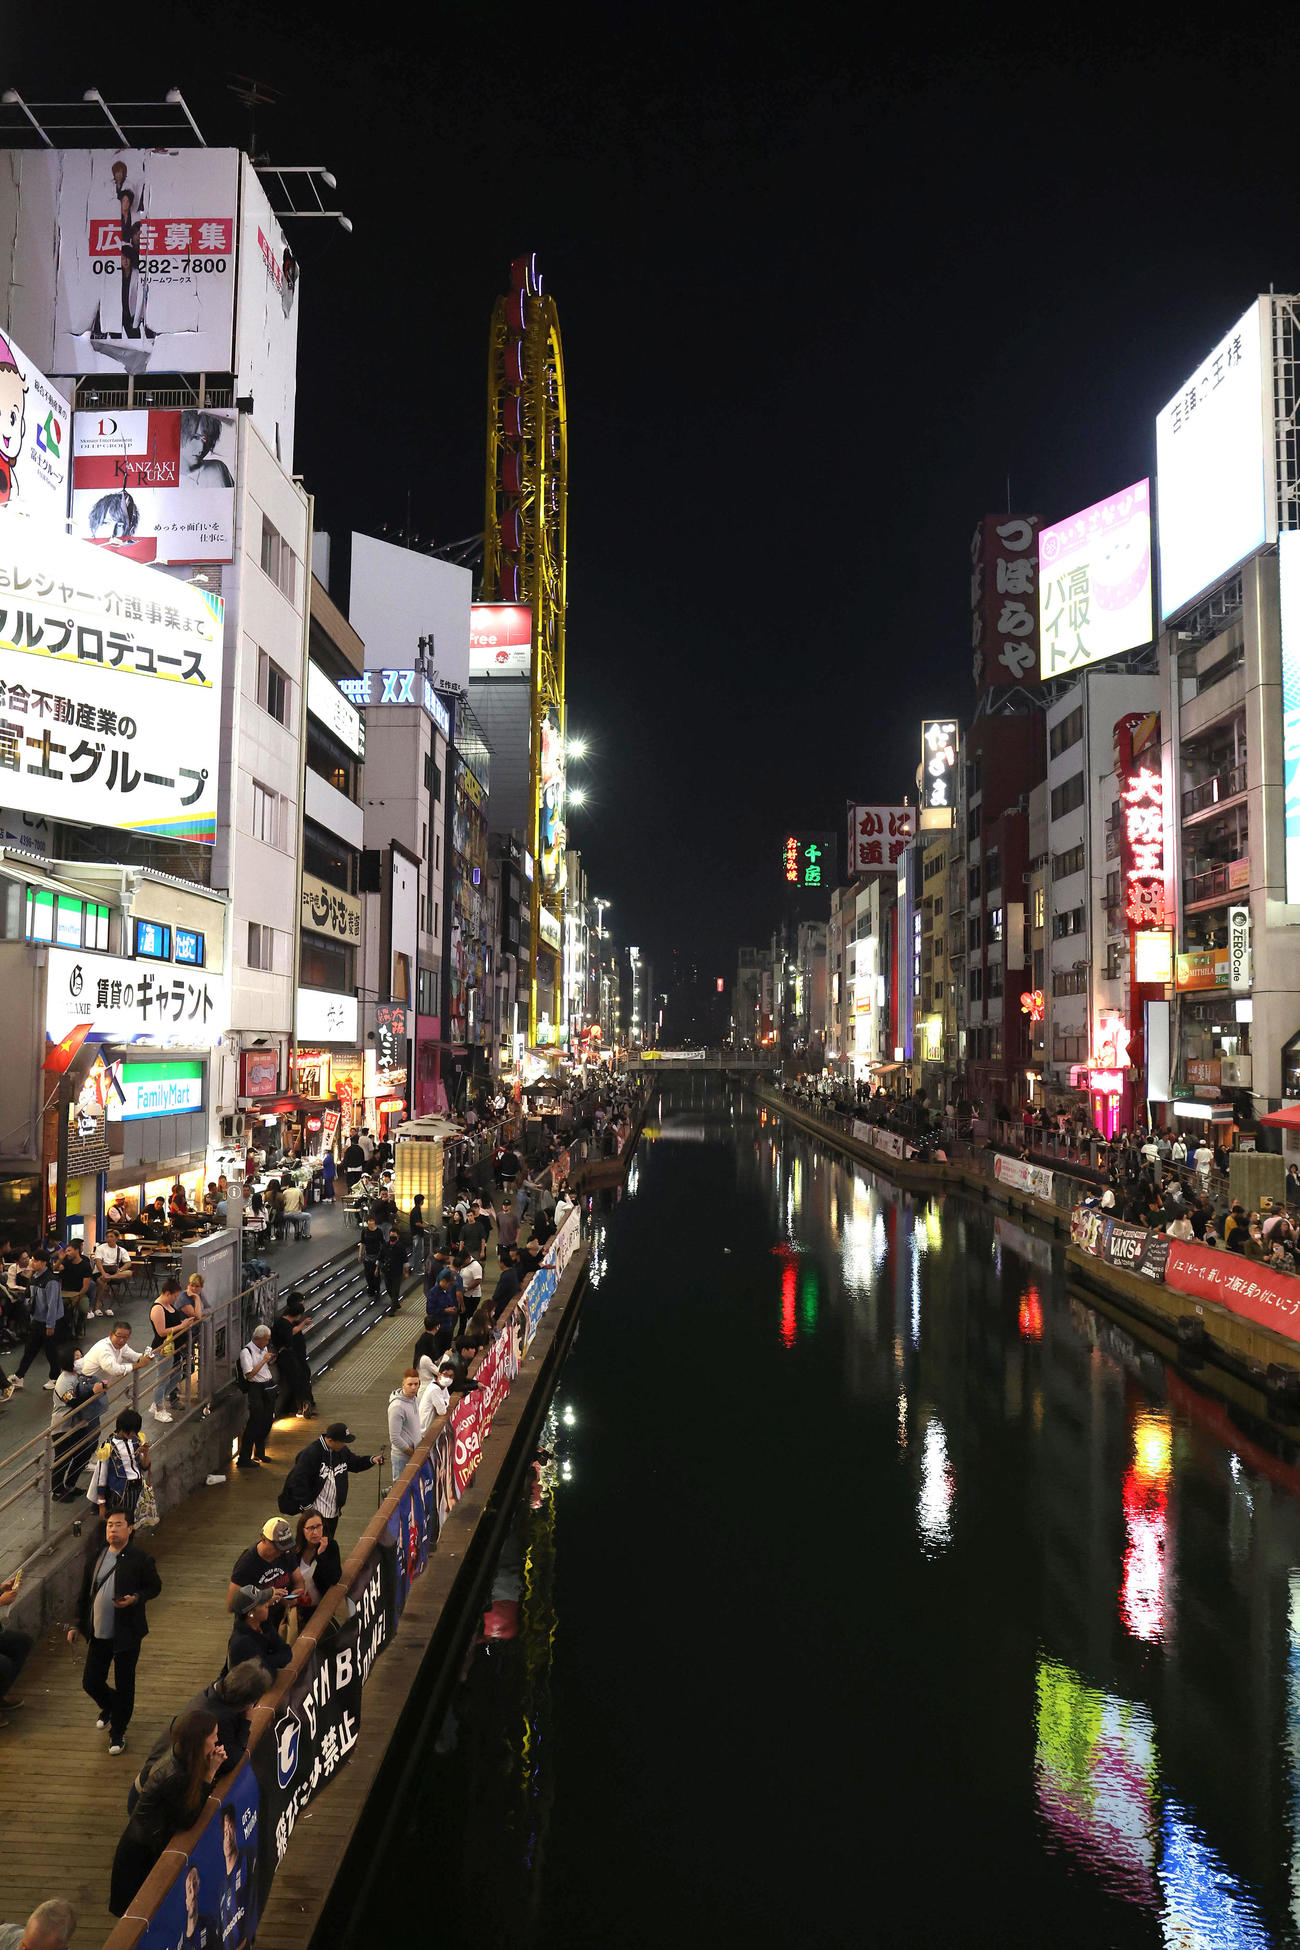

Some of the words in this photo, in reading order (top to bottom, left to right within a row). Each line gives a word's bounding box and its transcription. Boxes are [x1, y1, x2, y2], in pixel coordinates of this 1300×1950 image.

[92, 258, 227, 275] 06-282-7800
[140, 276, 192, 284] ドリームワークス
[115, 460, 175, 477] KANZAKI
[138, 471, 175, 485] RUKA
[154, 521, 219, 532] めっちゃ面白いを
[996, 516, 1038, 679] づぼらや
[1067, 563, 1091, 664] 高収入
[1045, 573, 1066, 672] バイト
[0, 609, 207, 684] ルプロデュース
[0, 680, 137, 740] 合不動産業の
[0, 718, 209, 806] 富士グループ
[859, 811, 912, 837] かに
[786, 837, 798, 881] お好み焼
[804, 844, 822, 882] 千房
[1121, 767, 1165, 924] 大阪王将
[312, 886, 347, 935] うなぎ
[141, 924, 155, 953] 酒
[175, 934, 196, 960] たばこ
[96, 974, 213, 1024] 賃貸のギャラント
[137, 1083, 190, 1110] FamilyMart
